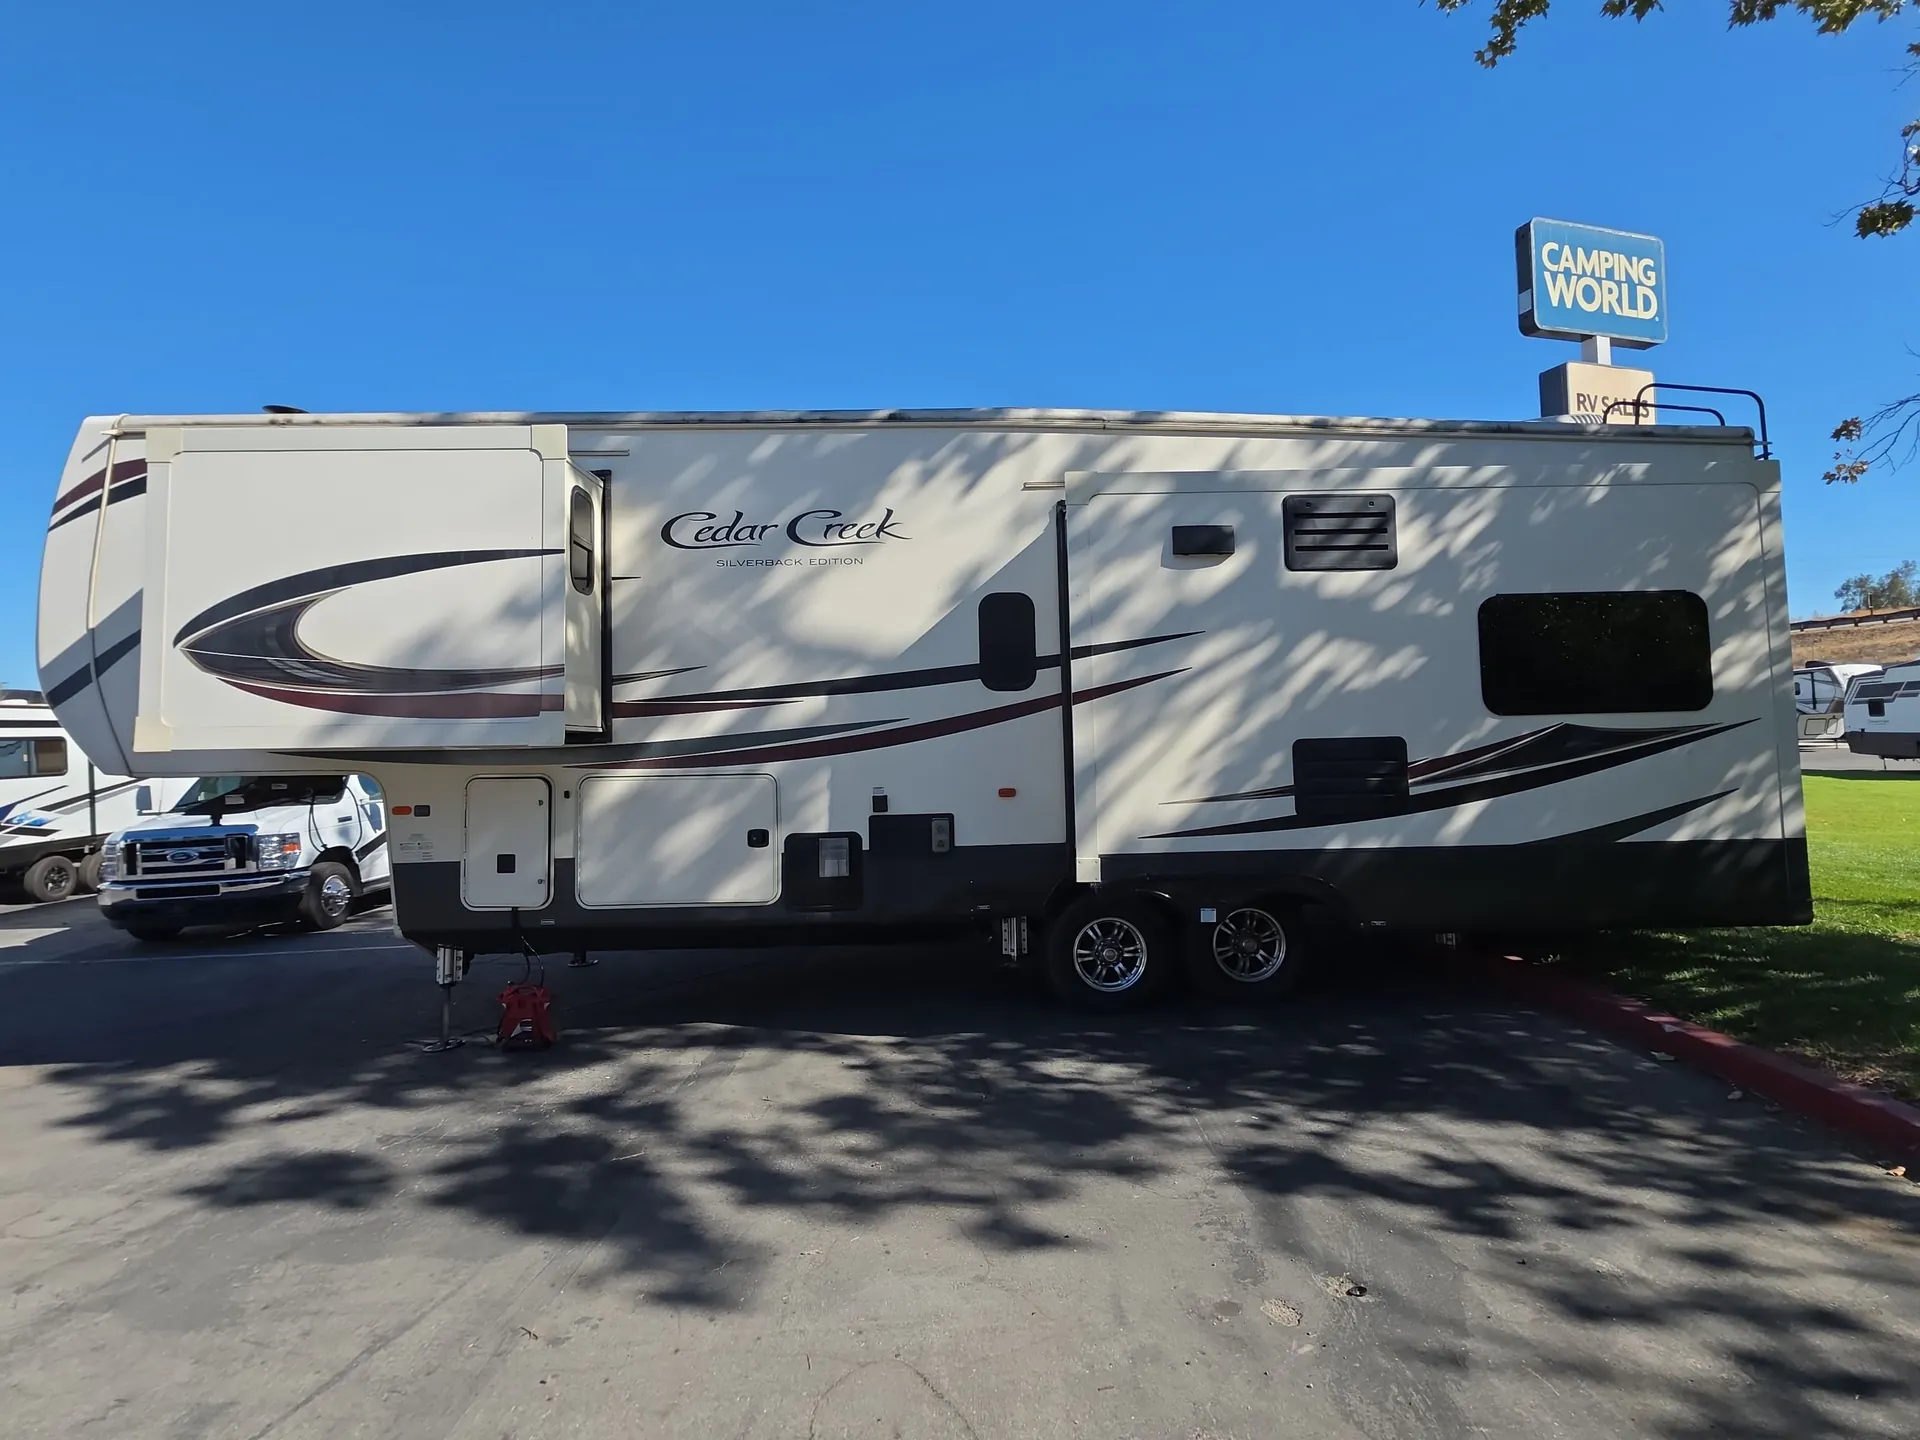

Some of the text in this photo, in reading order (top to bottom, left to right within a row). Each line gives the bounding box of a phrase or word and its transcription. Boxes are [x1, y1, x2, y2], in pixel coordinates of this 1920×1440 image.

[1541, 242, 1656, 287] CAMPING
[1543, 271, 1658, 320] WORLD
[1576, 392, 1598, 413] RV
[660, 507, 913, 550] Cedar Creek
[716, 557, 864, 568] SILVERBACK EDITION
